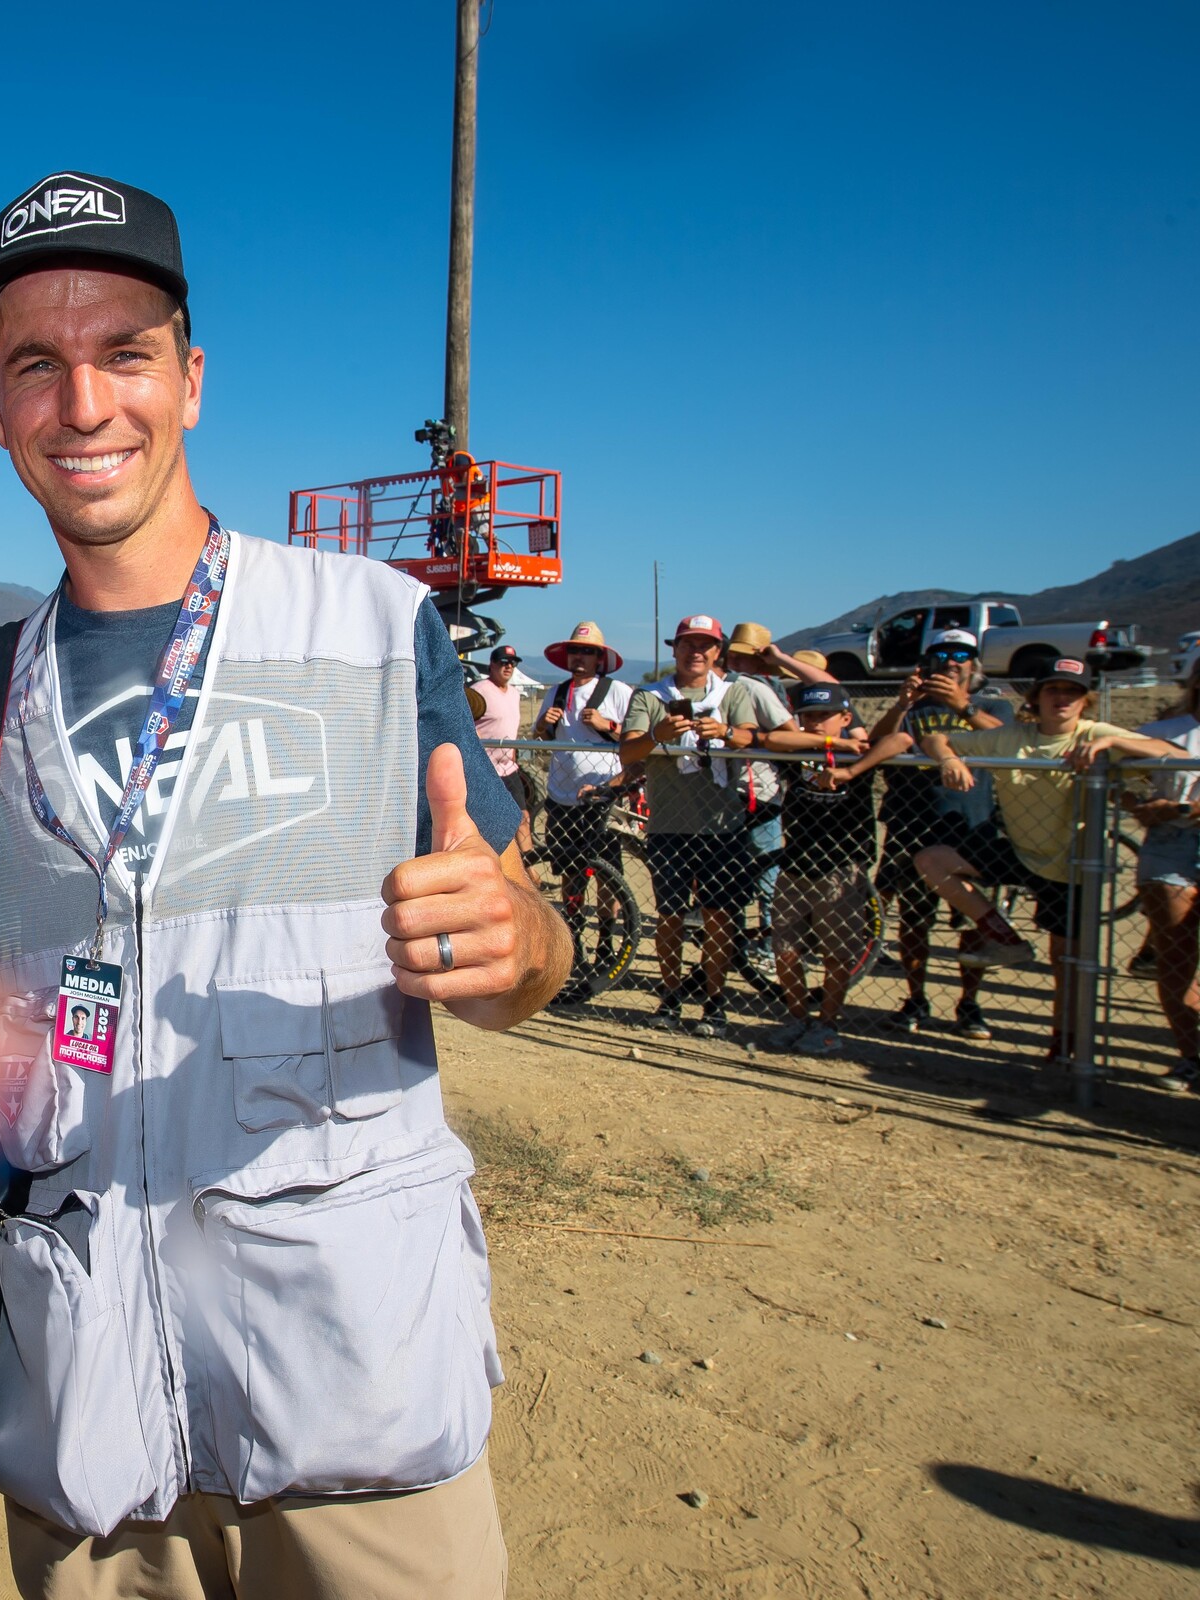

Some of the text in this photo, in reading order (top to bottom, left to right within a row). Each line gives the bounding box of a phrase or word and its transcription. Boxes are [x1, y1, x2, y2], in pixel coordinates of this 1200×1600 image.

[5, 188, 121, 238] O'NEAL
[205, 542, 216, 564] LUCAS
[163, 640, 183, 678] LUCAS OIL
[171, 628, 200, 697] MOTOCROSS
[120, 753, 154, 826] MOTOCROSS
[121, 782, 133, 809] LUCAS
[119, 842, 159, 864] ENJO
[65, 973, 115, 996] MEDIA
[97, 1007, 109, 1041] 2021
[59, 1048, 107, 1065] MOTOCROSS
[71, 1040, 98, 1052] LUCAS OIL
